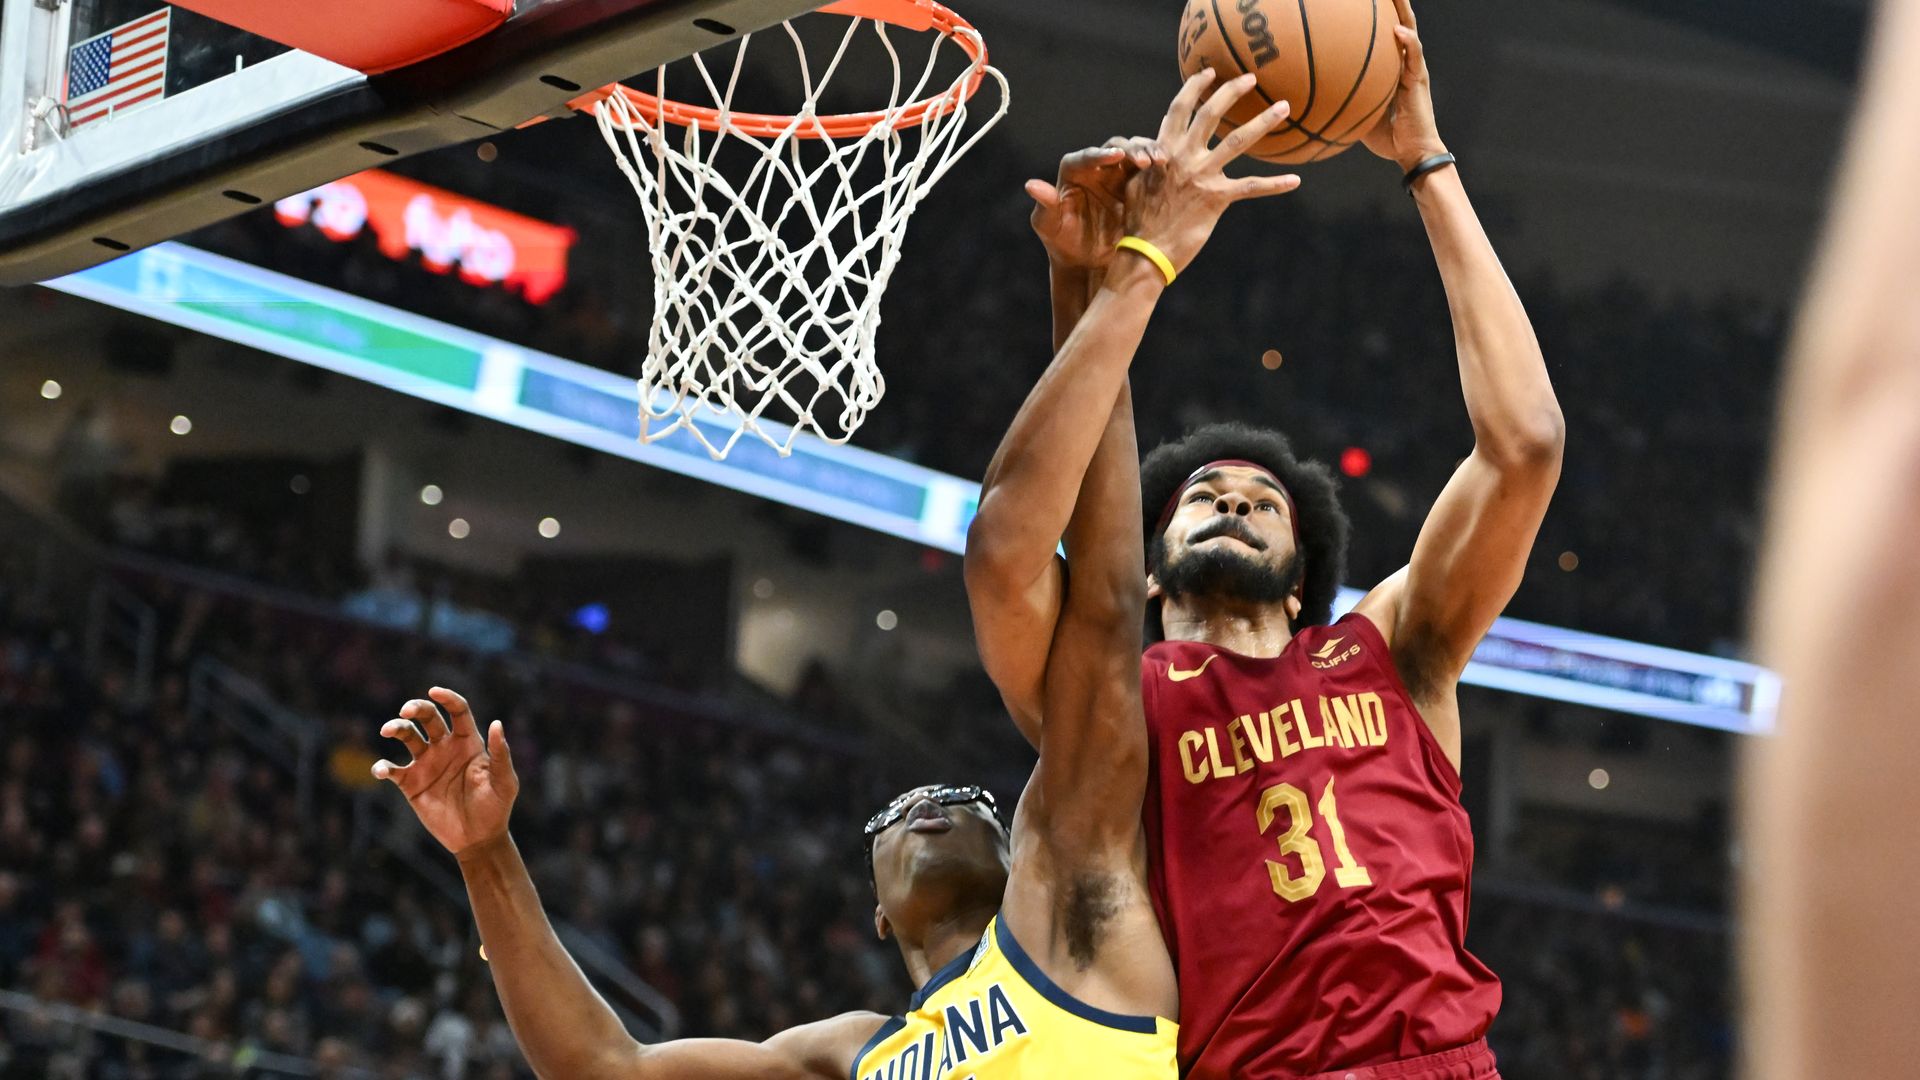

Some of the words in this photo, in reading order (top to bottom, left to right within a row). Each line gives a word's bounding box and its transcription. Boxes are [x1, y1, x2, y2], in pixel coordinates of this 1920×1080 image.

[1311, 644, 1361, 669] CLIFFS
[1178, 692, 1389, 784] CLEVELAND
[1256, 775, 1373, 902] 31
[862, 983, 1028, 1080] DIANA
